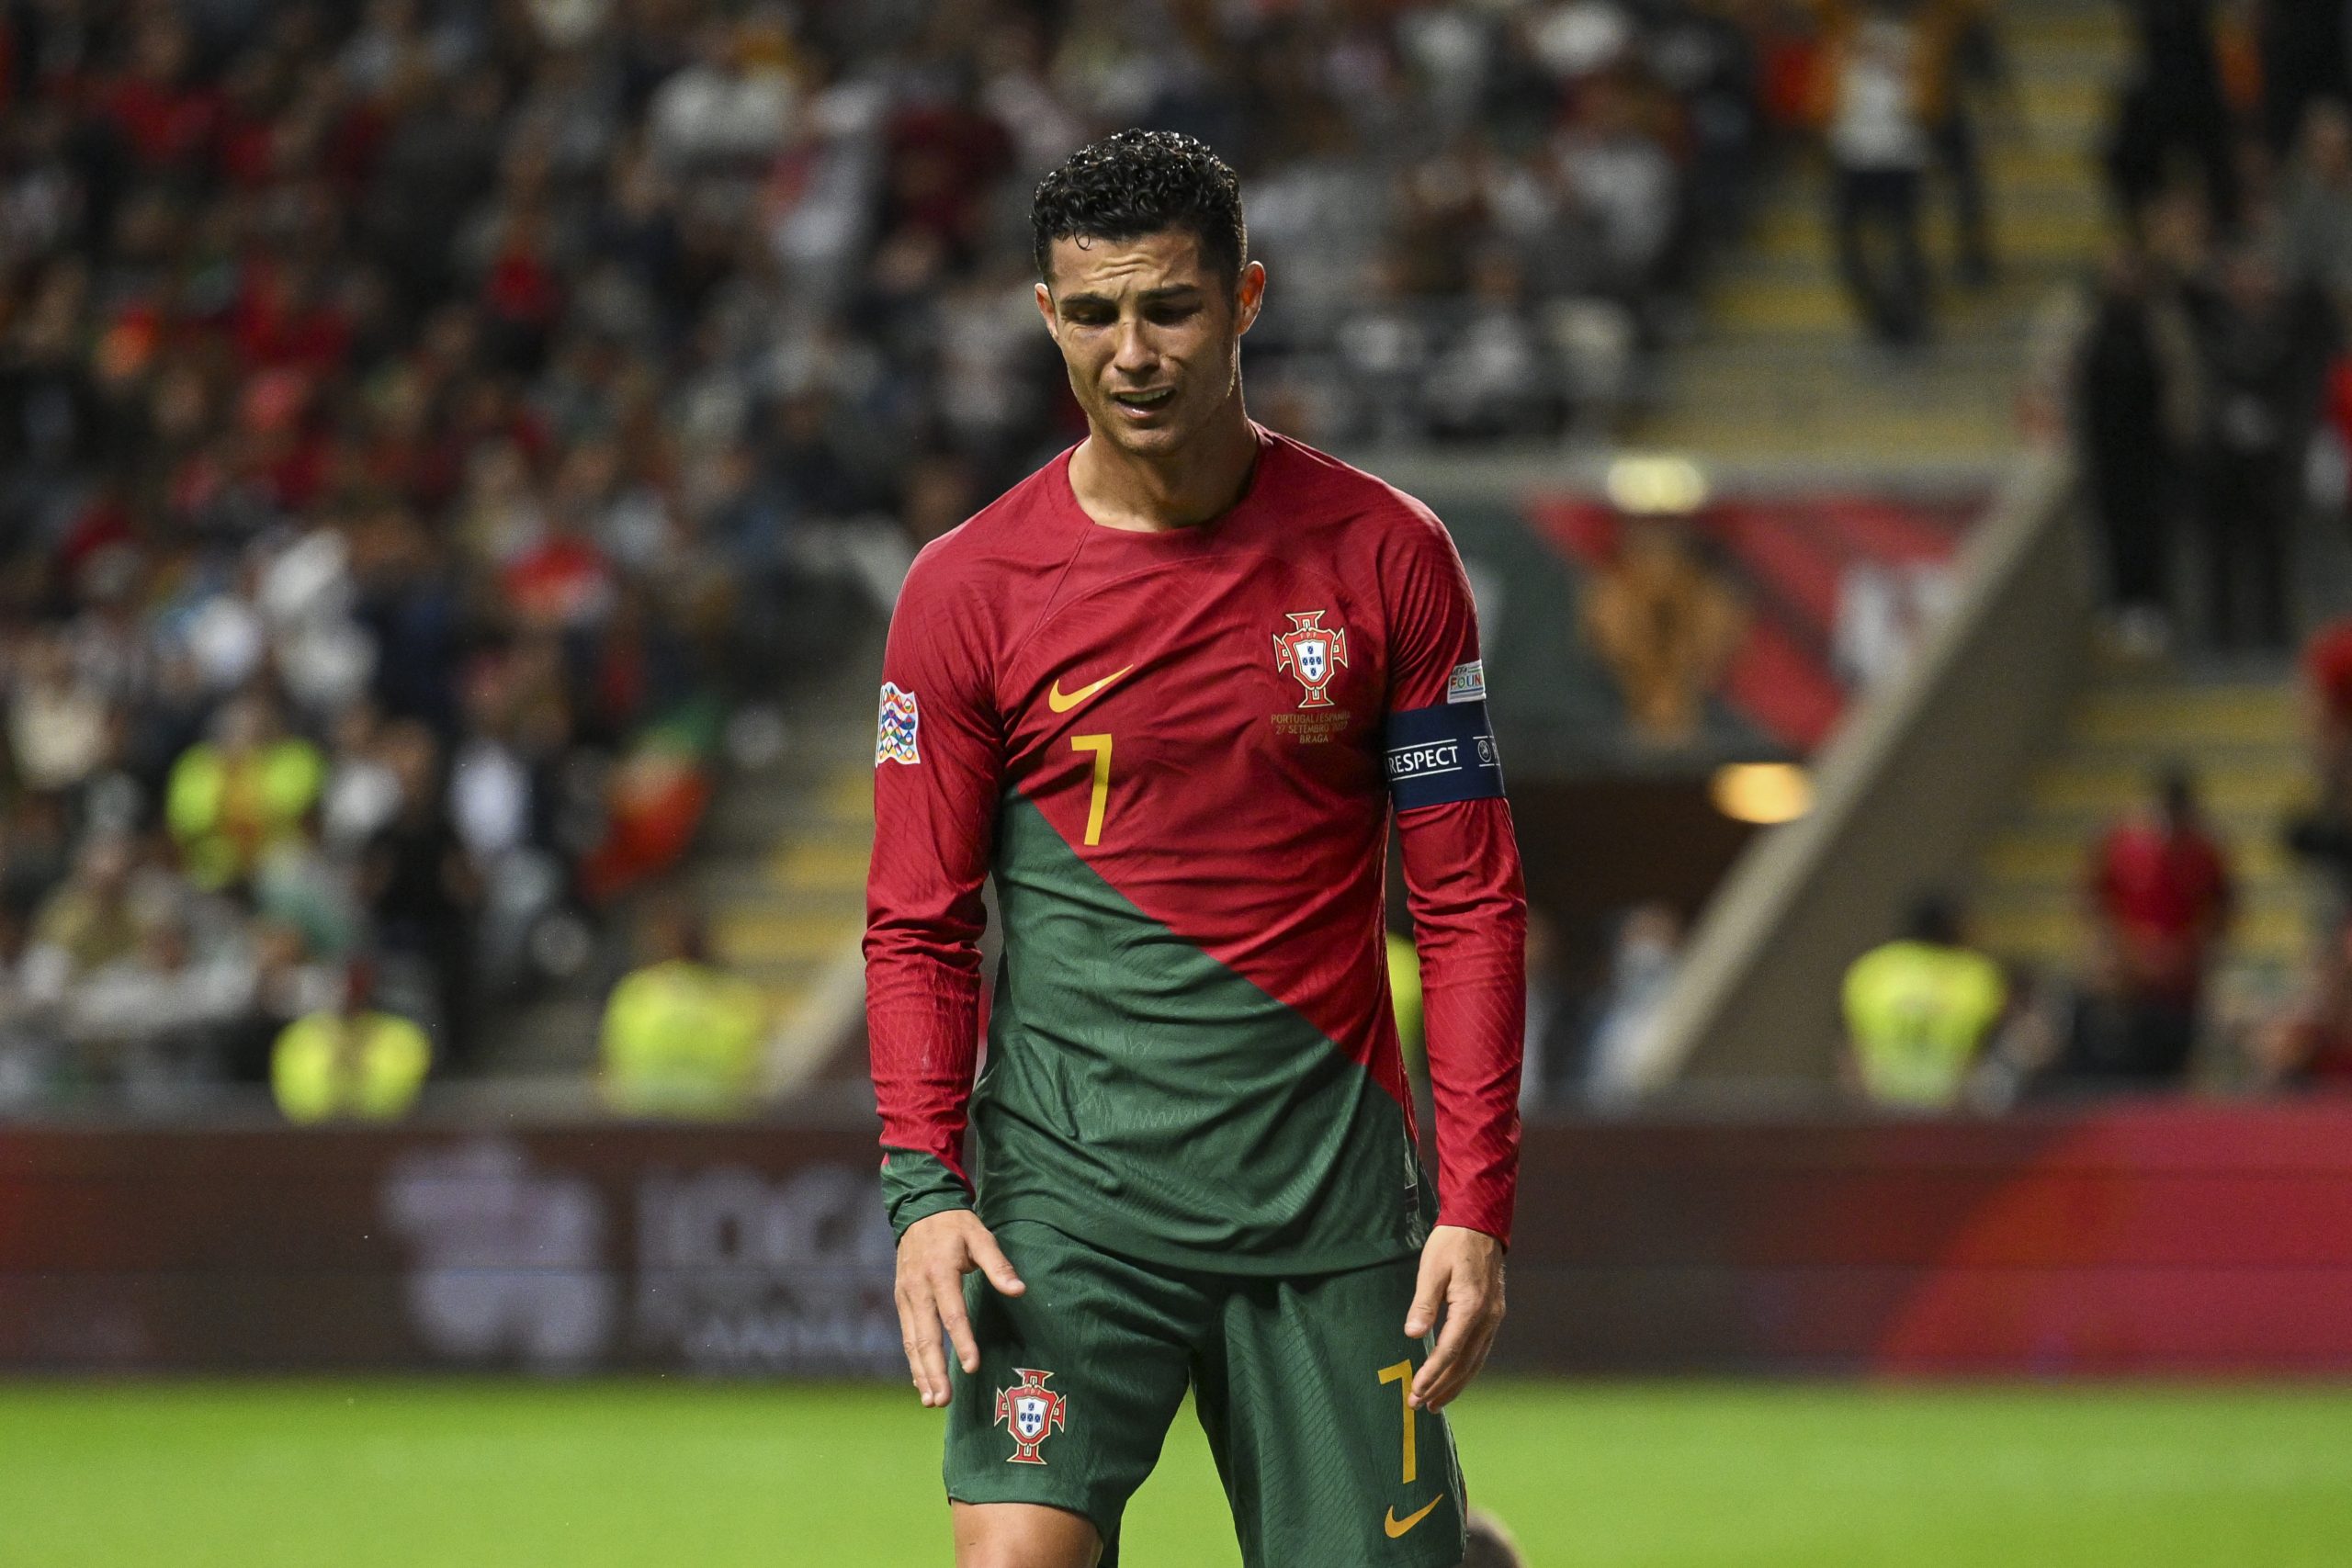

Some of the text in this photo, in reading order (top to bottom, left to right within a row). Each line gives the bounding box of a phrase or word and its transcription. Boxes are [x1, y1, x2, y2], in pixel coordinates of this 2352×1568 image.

[1288, 723, 1329, 735] SETEMBRO
[1299, 734, 1329, 744] BRAGA
[1387, 746, 1459, 774] RESPECT
[1070, 733, 1113, 846] 7
[1378, 1359, 1417, 1484] 7
